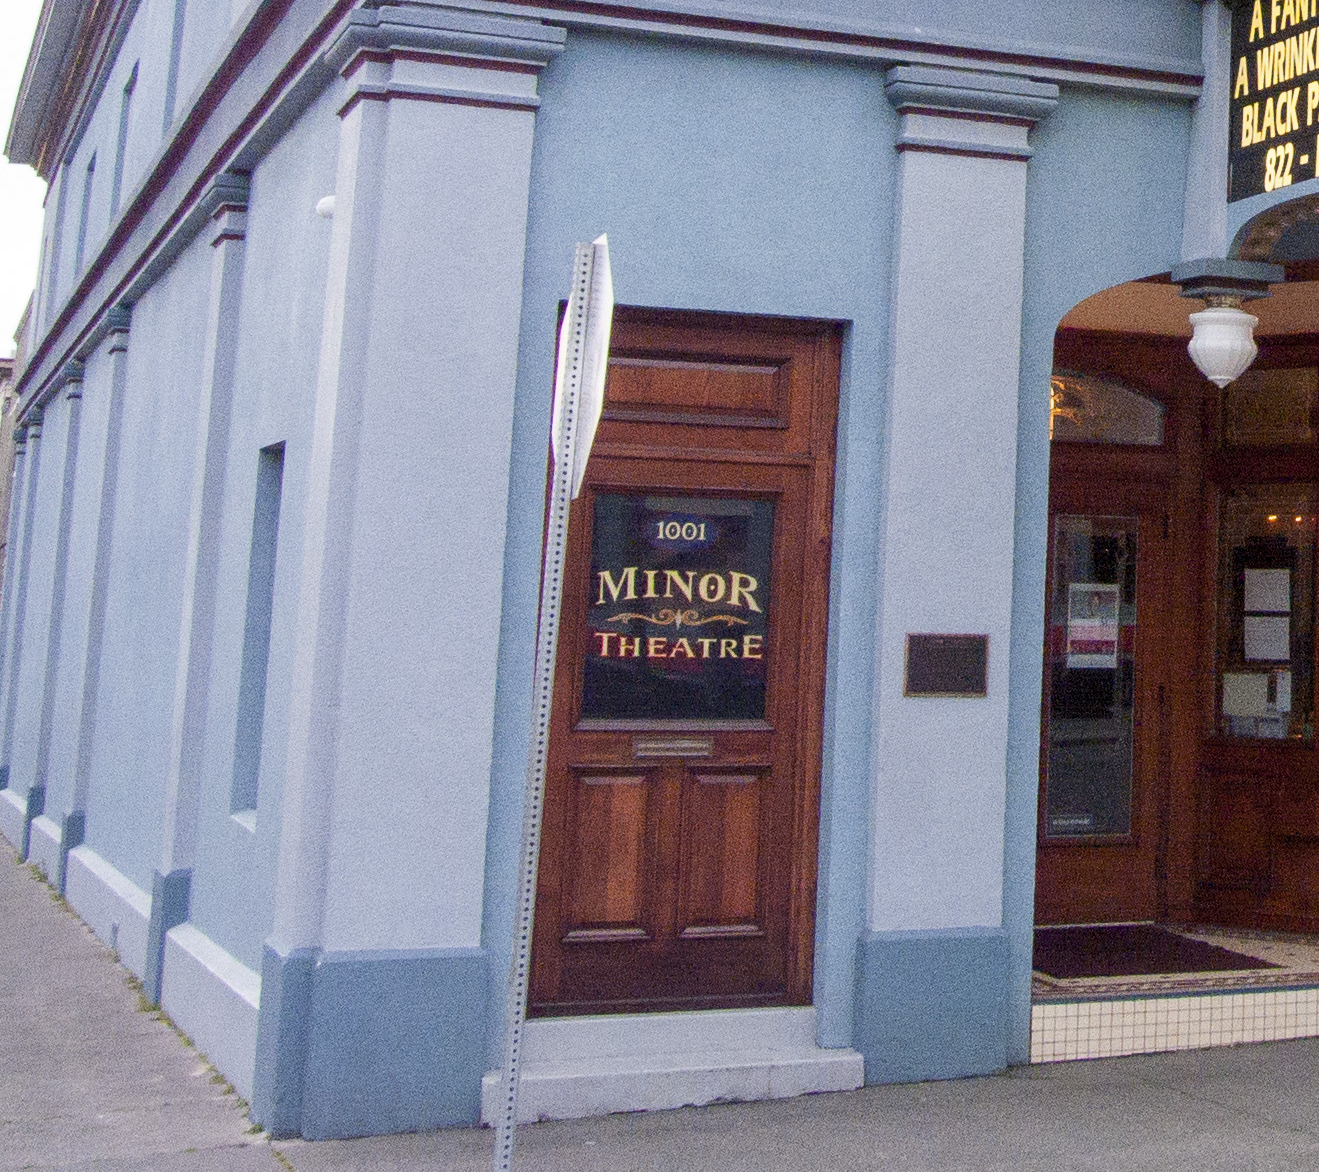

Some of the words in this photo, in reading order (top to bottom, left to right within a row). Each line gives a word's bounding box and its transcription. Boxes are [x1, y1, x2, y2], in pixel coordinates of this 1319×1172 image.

[1249, 0, 1264, 43] A
[1233, 56, 1249, 100] A
[1241, 86, 1301, 148] BLACK
[1264, 142, 1294, 192] 822
[656, 521, 706, 540] 1001
[596, 566, 763, 614] MINOR
[594, 632, 763, 659] THEATRE
